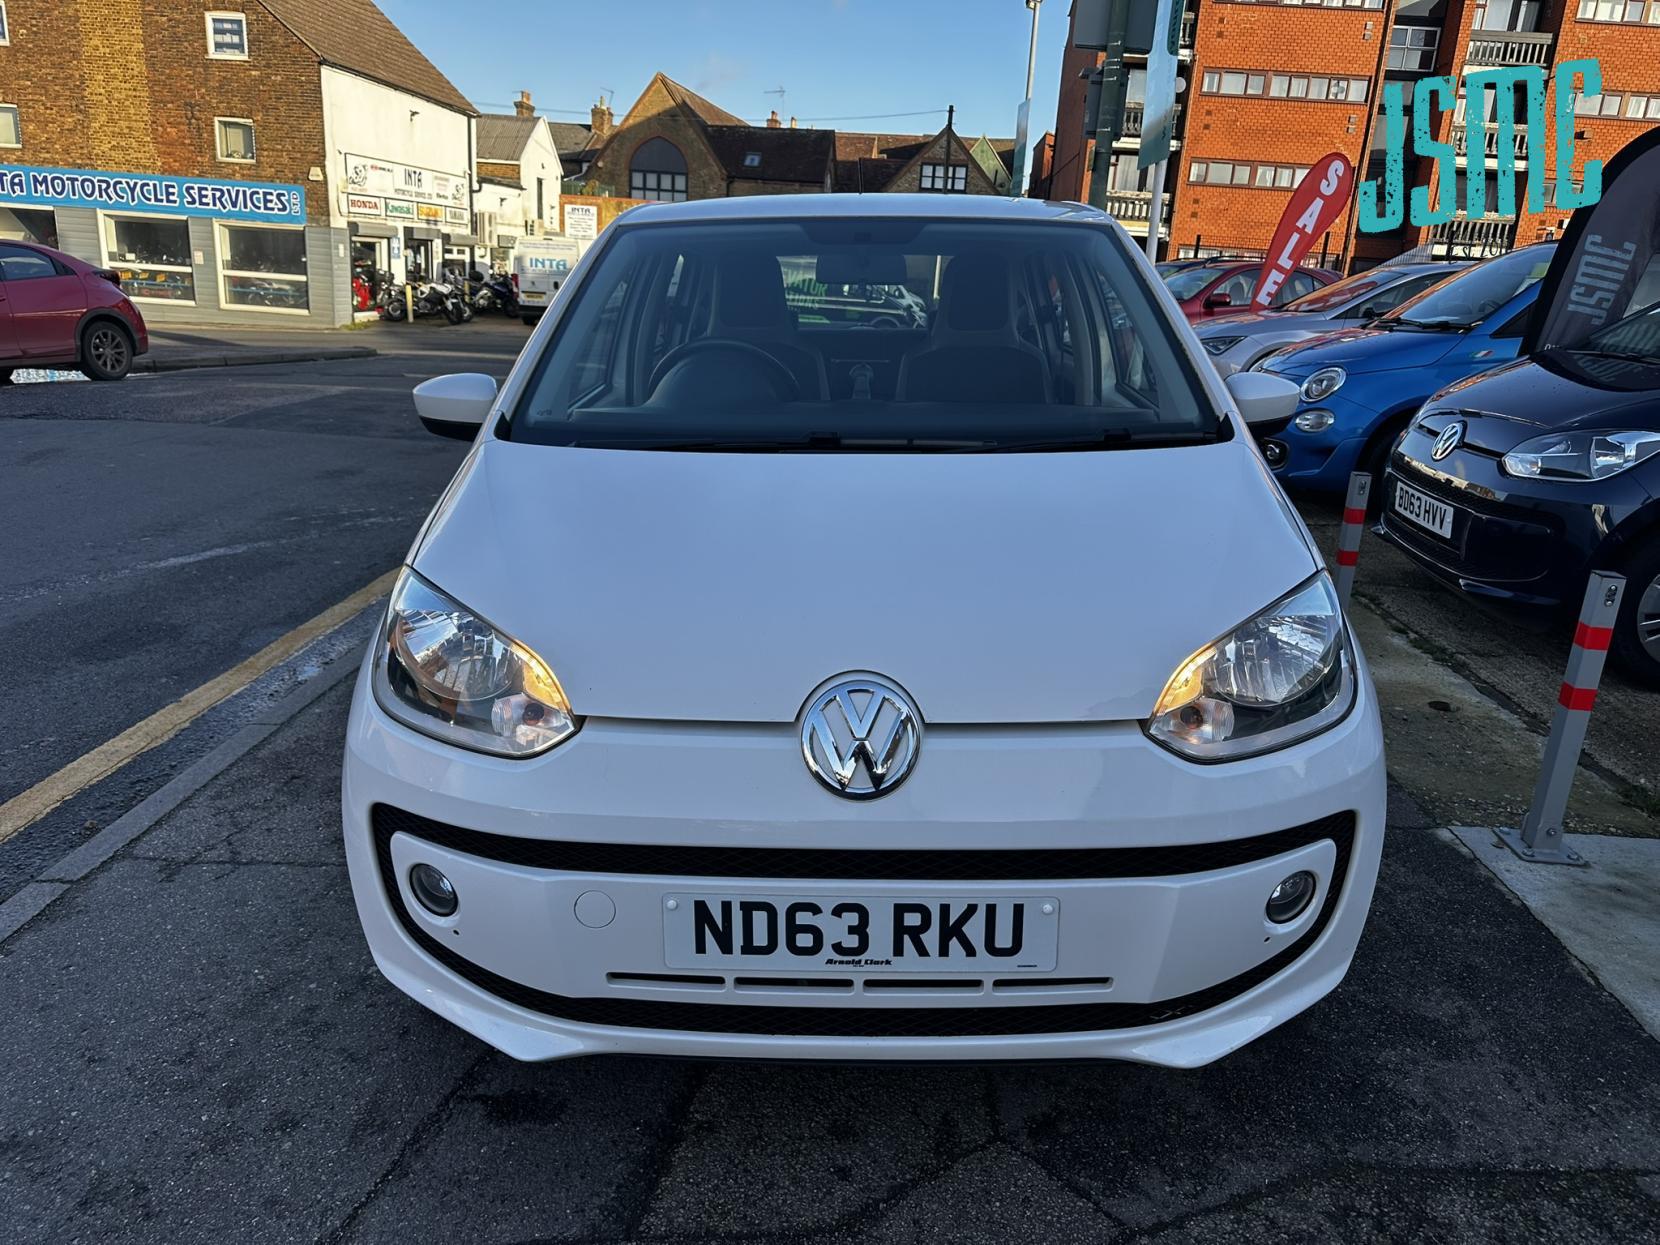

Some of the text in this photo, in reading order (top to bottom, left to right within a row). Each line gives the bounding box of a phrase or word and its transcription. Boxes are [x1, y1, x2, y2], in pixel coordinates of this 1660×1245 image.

[31, 173, 178, 206] MOTORCYCLE
[184, 184, 289, 214] SERVICES
[404, 168, 423, 189] INTA
[290, 192, 300, 215] LTD
[350, 199, 379, 210] HONDA
[1255, 159, 1345, 307] SALE
[529, 257, 568, 271] INTA
[1566, 234, 1638, 326] JSMC
[1398, 486, 1447, 530] BD63 HVV
[693, 899, 1025, 958] ND63 RKU
[825, 958, 893, 966] Arnold Clark
